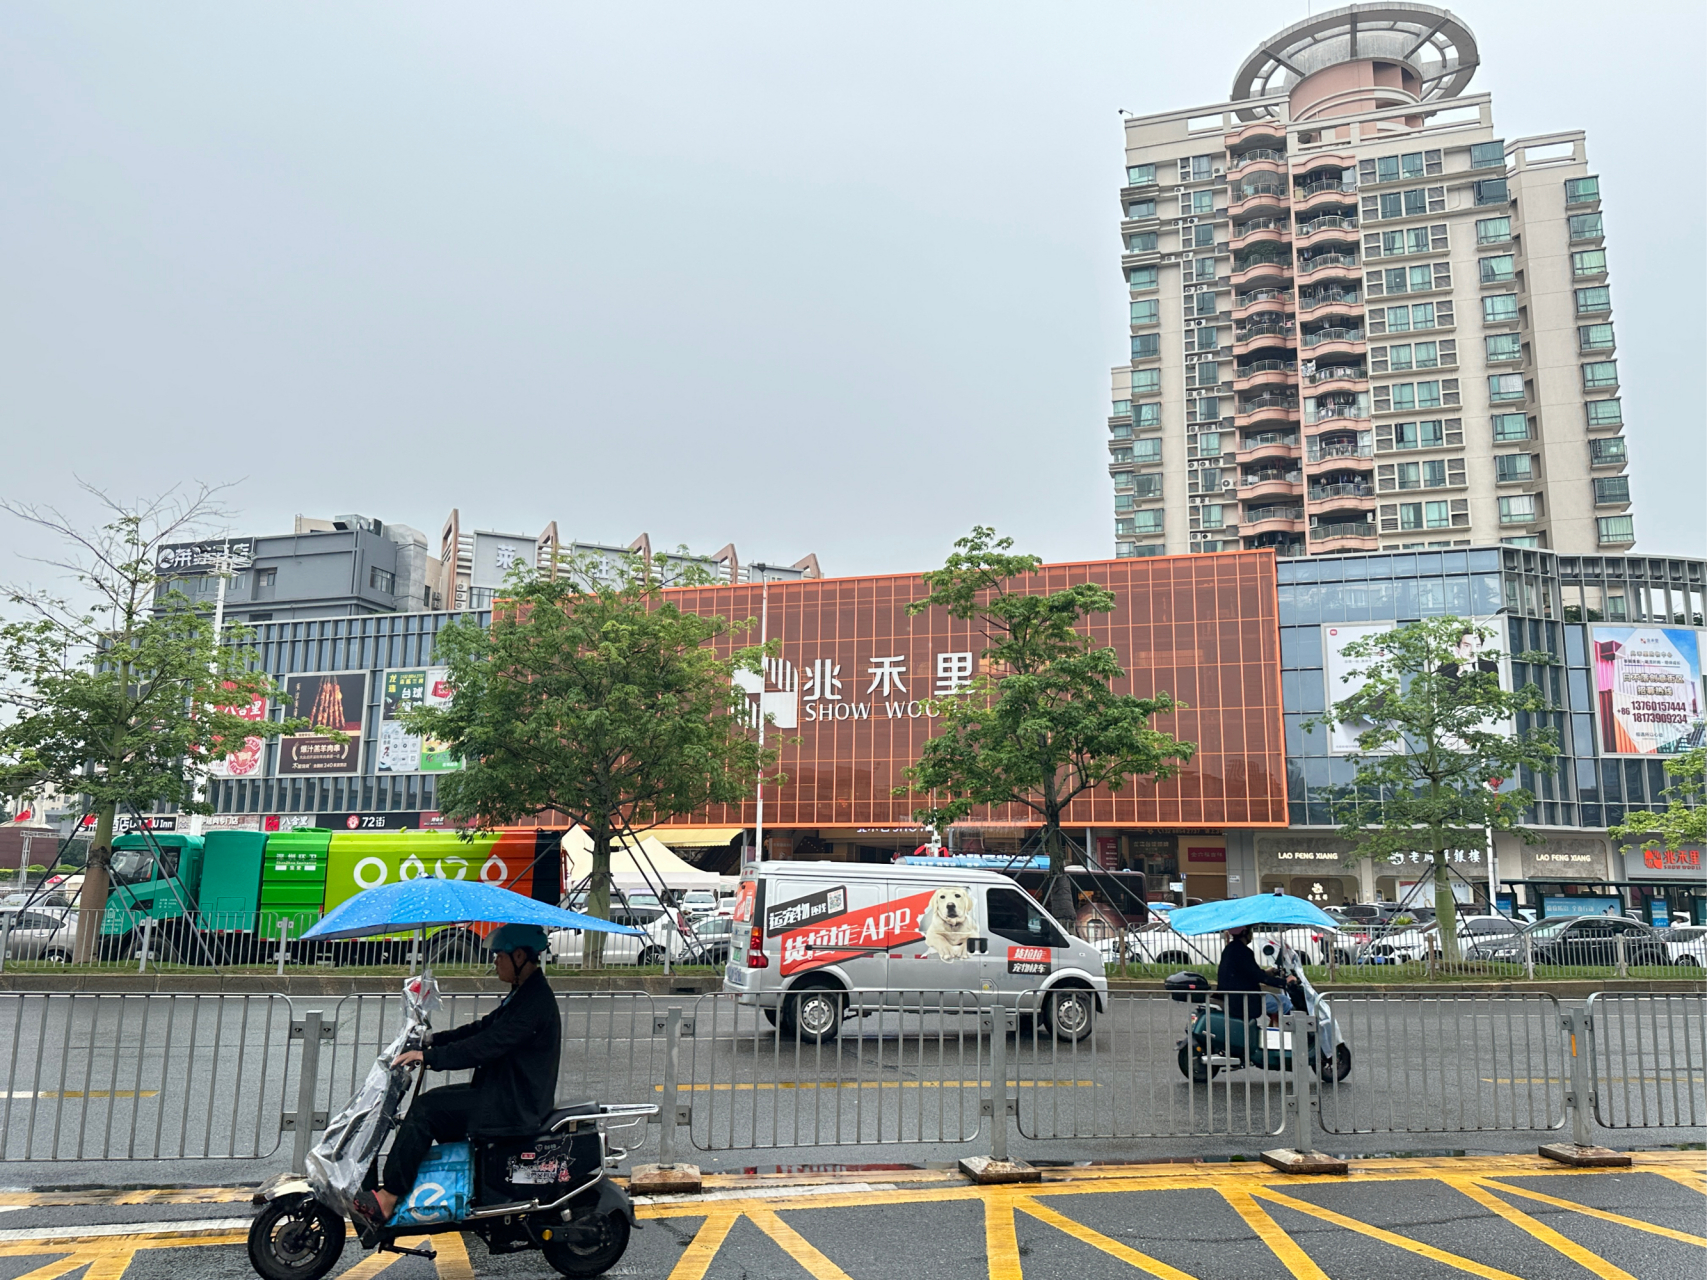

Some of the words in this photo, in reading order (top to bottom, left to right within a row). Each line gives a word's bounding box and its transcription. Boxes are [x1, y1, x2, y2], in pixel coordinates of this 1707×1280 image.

[496, 545, 516, 569] 莱
[803, 652, 976, 701] 兆禾里
[402, 687, 423, 699] 台球
[805, 702, 871, 721] SHOW
[1617, 707, 1630, 715] +86
[362, 816, 385, 827] 72街
[1664, 850, 1700, 865] 兆禾里
[769, 902, 810, 931] 运宠物
[783, 924, 855, 965] 货拉拉
[859, 907, 911, 944] APP
[1012, 963, 1046, 973] 宠物快车
